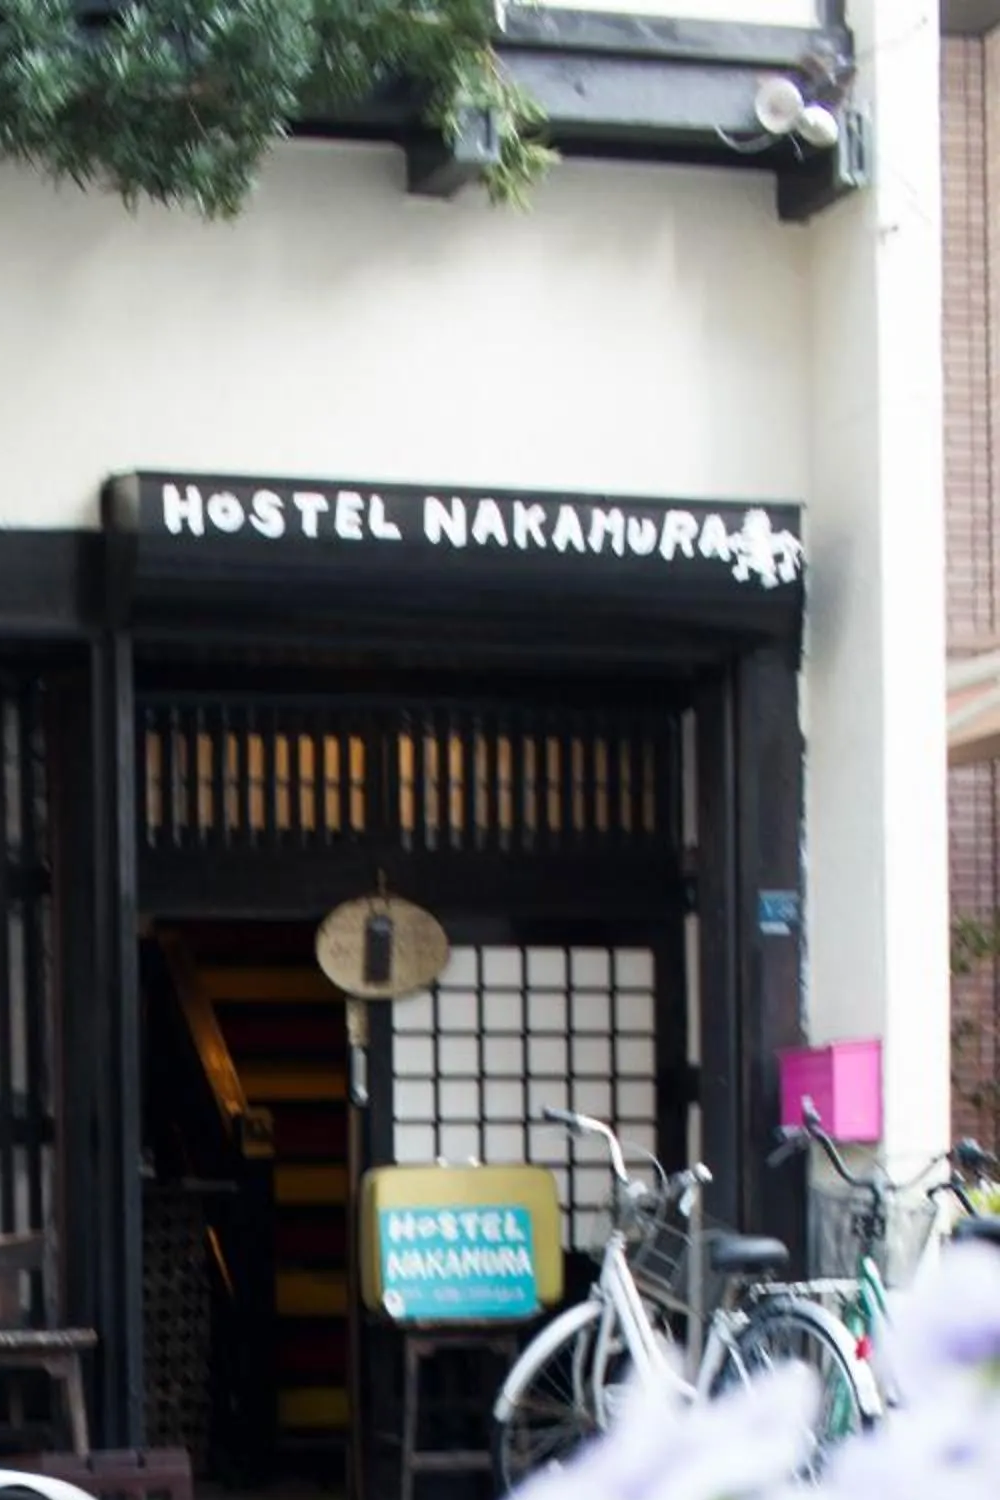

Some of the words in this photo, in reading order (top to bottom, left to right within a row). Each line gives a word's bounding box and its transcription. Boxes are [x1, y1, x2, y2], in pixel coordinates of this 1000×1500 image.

[161, 483, 403, 540] HOSTEL
[424, 495, 731, 563] NAKAMURA
[388, 1211, 526, 1243] HOSTEL
[386, 1246, 534, 1281] NAKAMURA
